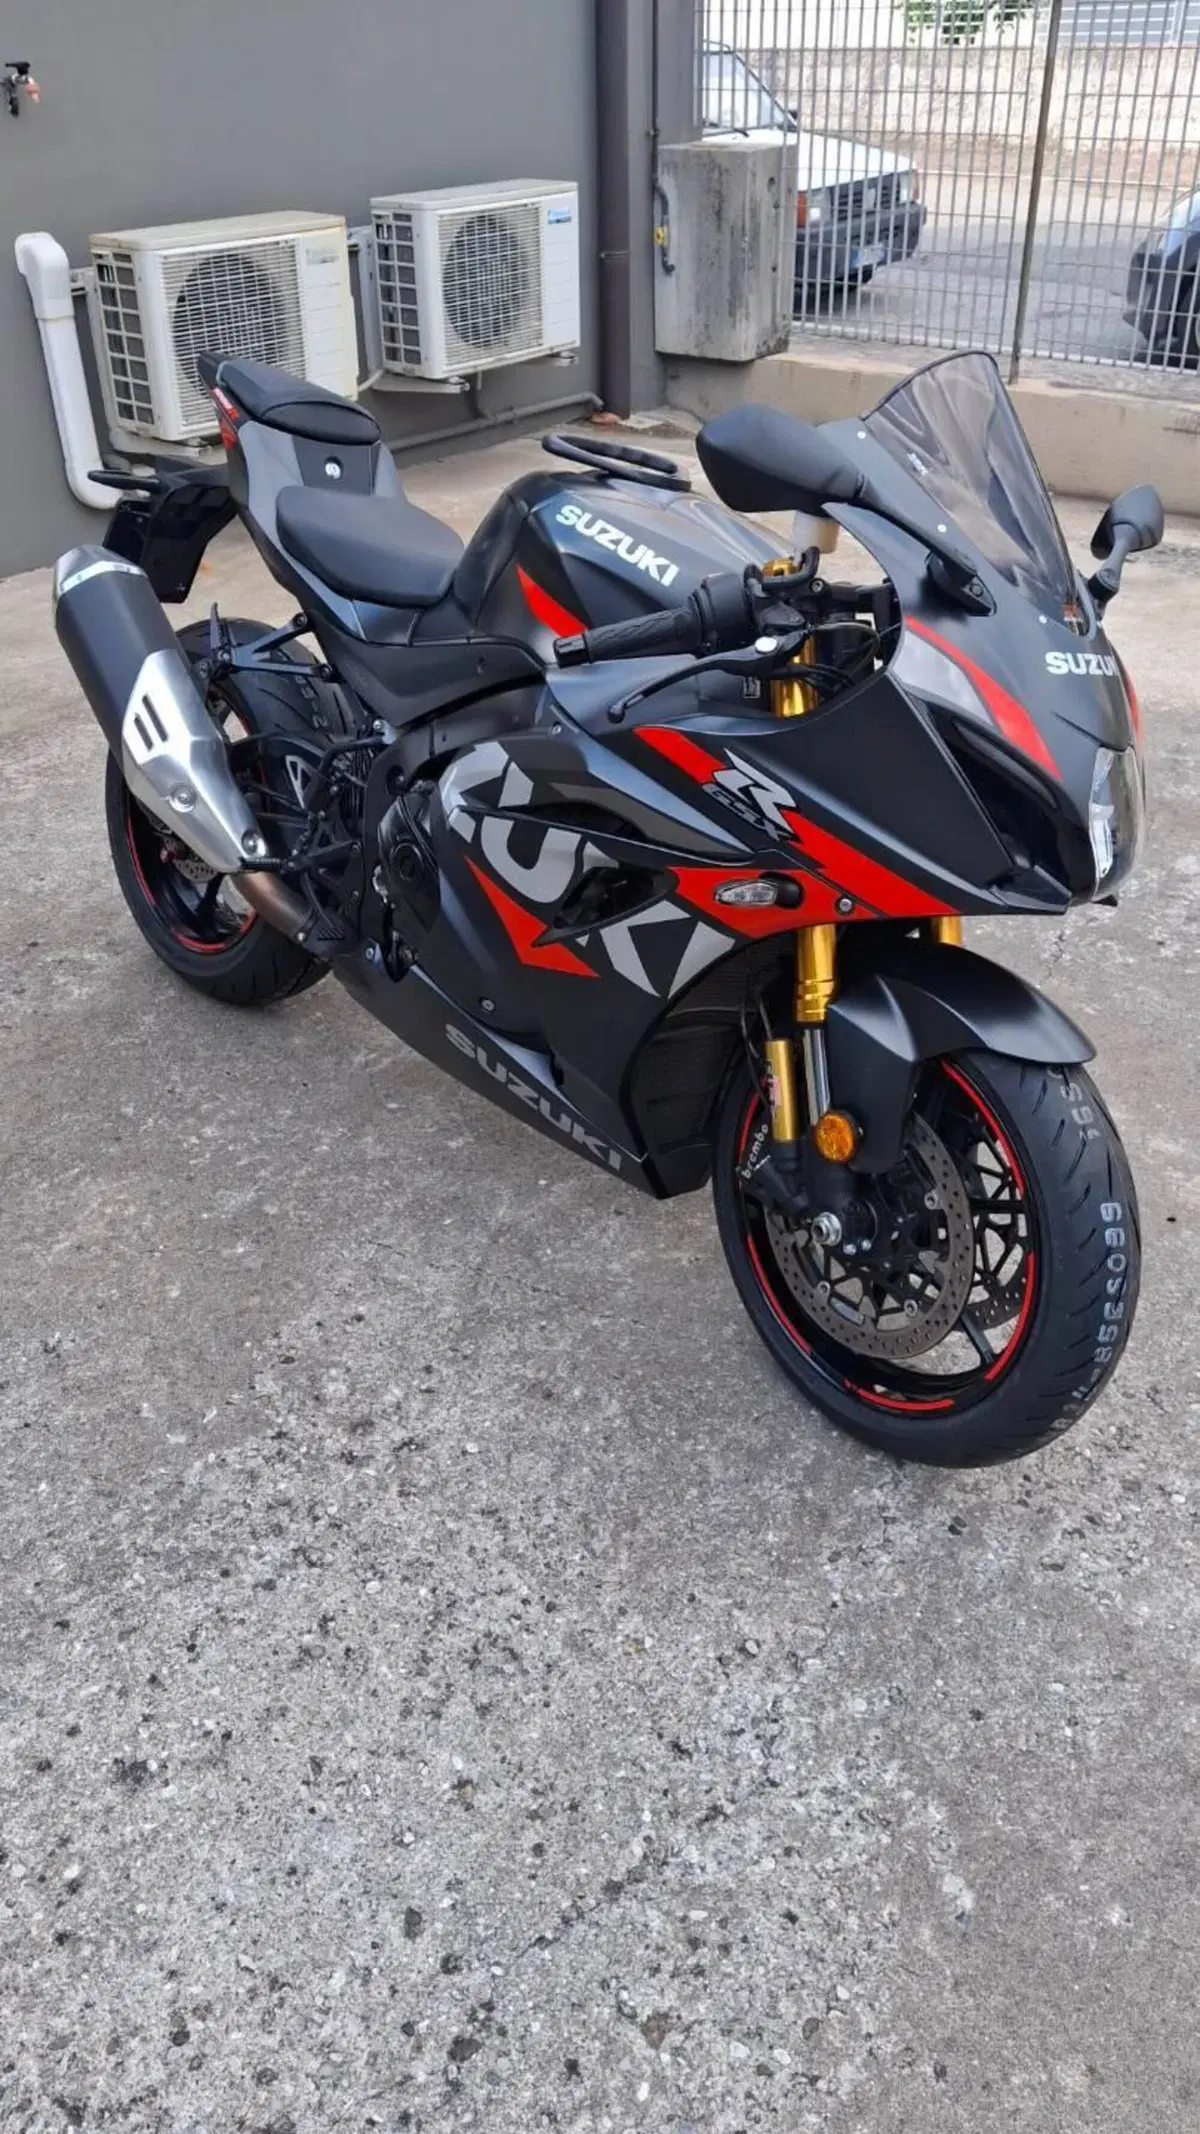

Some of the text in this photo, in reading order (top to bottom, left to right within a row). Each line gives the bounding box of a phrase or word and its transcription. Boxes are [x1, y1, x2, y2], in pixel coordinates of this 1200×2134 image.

[555, 504, 680, 587] SUZUKI
[445, 1023, 622, 1171] SUZUKI
[741, 1124, 769, 1180] brembo
